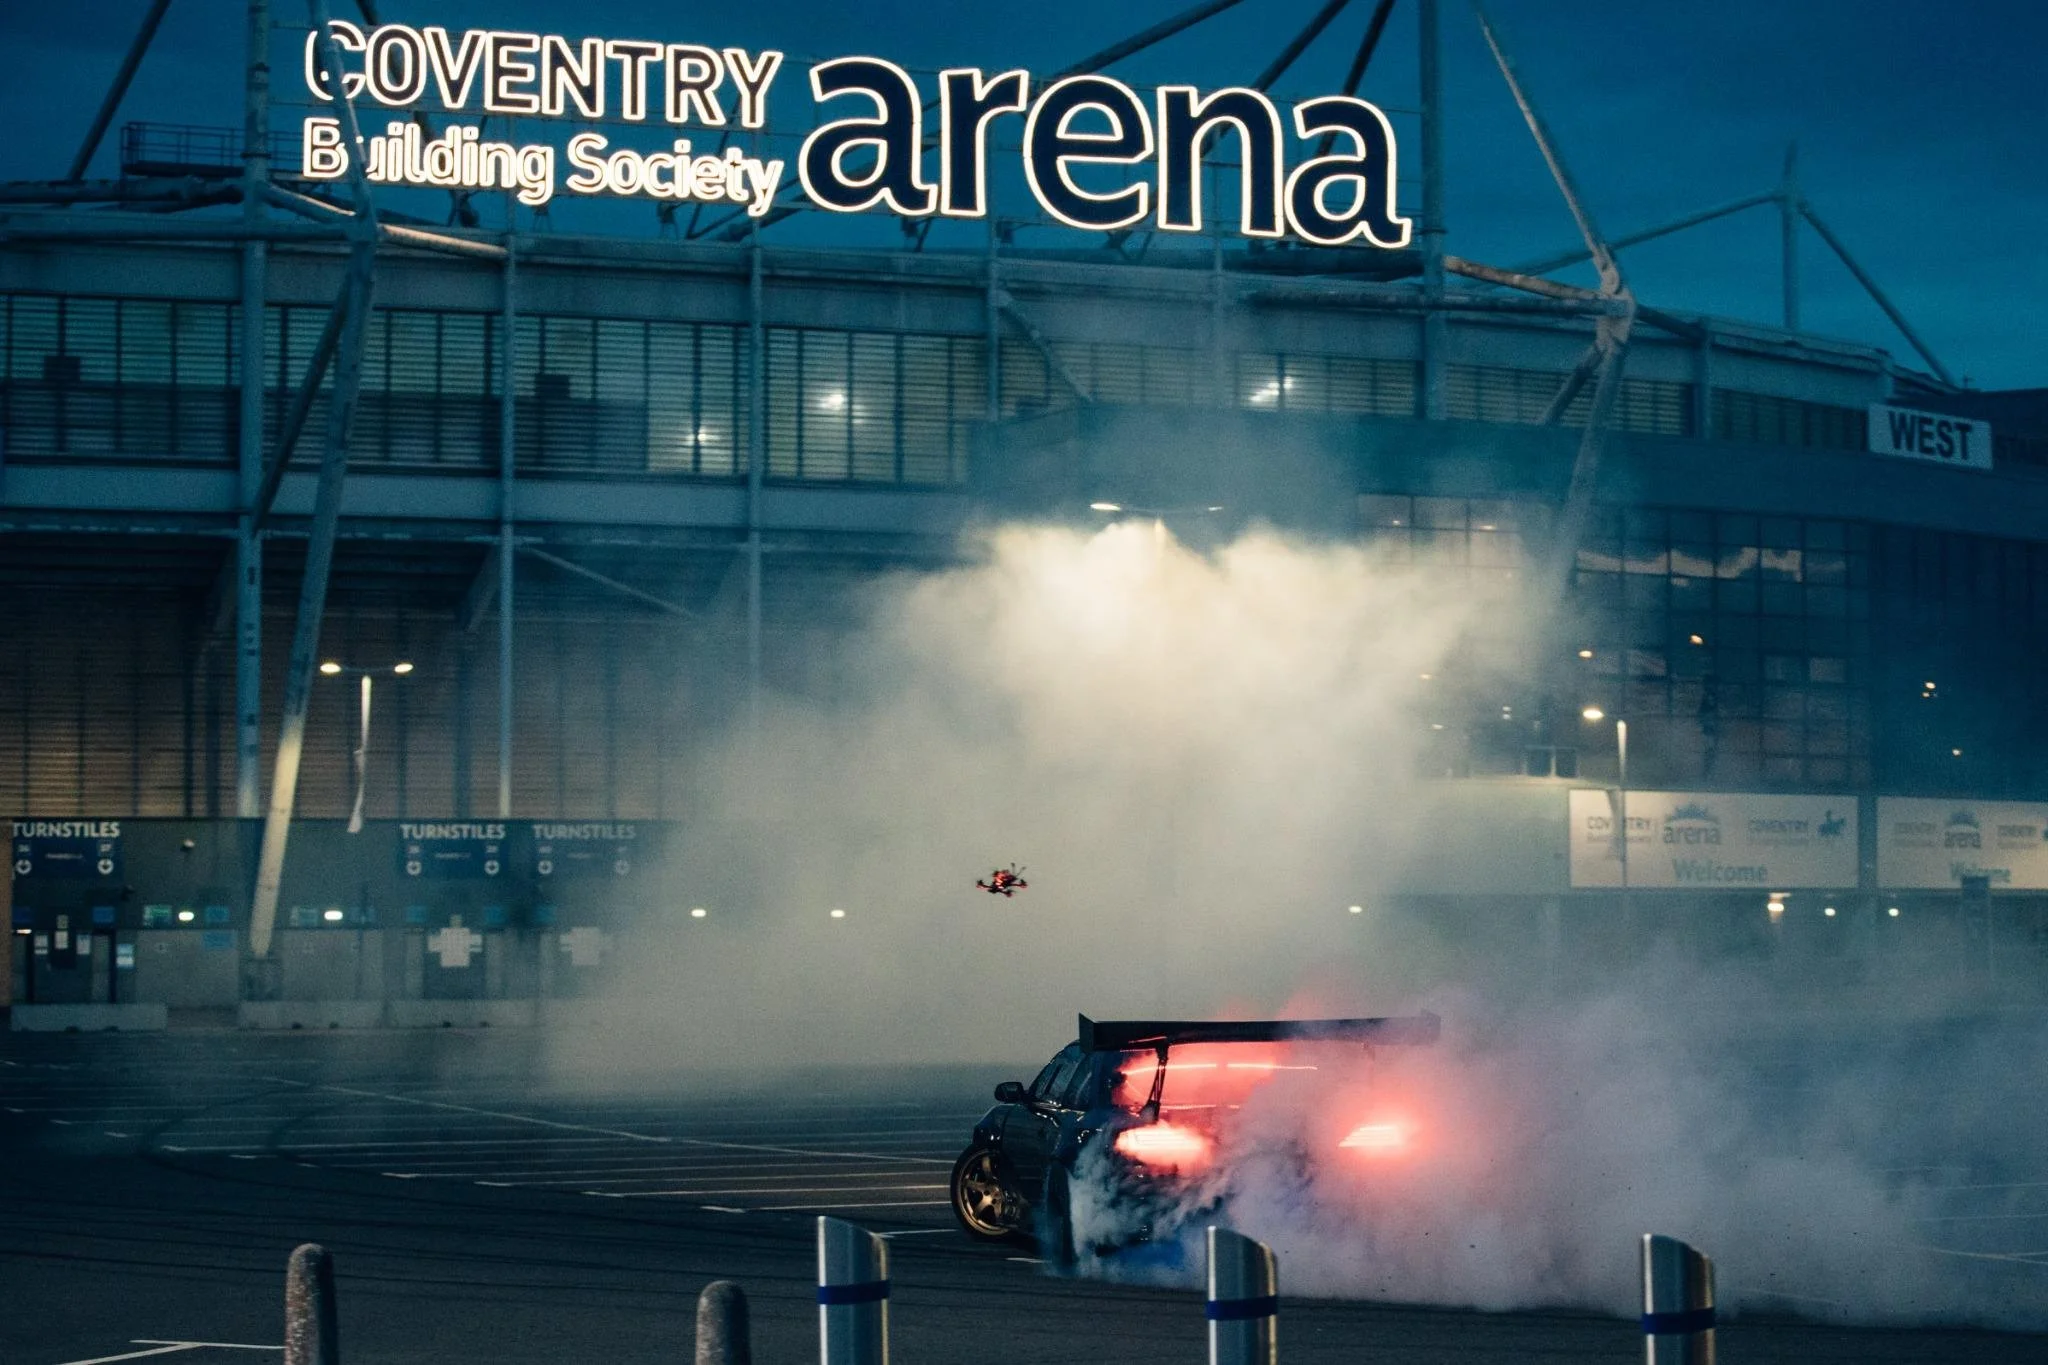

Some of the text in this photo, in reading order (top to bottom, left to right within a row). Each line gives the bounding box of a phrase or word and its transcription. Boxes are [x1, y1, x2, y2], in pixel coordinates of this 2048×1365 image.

[305, 20, 784, 128] COVENTRY
[799, 56, 1412, 248] arena
[566, 133, 784, 217] Society
[1887, 410, 1973, 461] WEST
[12, 821, 120, 838] TURNSTILES
[401, 823, 506, 840] TURNSTILES
[533, 824, 636, 840] TURNSTILES
[1587, 816, 1651, 831] COVTRY
[1663, 825, 1722, 845] arena
[1671, 859, 1768, 884] Welcome
